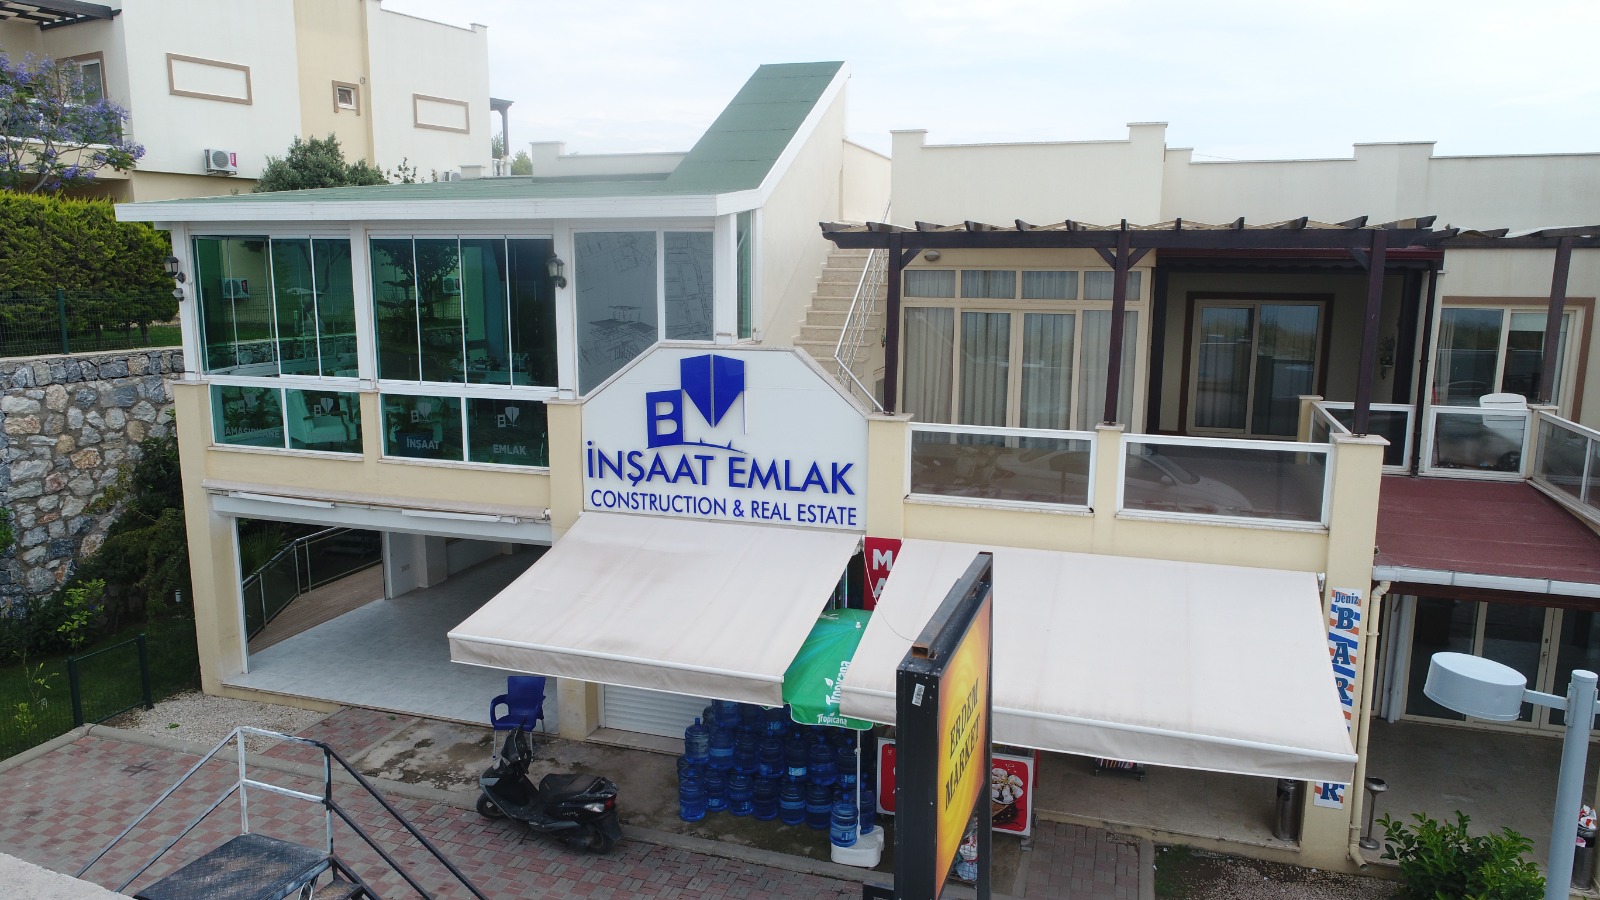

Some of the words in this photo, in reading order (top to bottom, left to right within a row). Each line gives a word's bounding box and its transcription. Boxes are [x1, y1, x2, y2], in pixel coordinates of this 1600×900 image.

[406, 437, 440, 450] İNŞAAT
[493, 444, 527, 455] EMLAK
[587, 440, 717, 487] İNŞAAT
[728, 456, 855, 496] EMLAK
[591, 489, 726, 516] CONSTRUCTION
[733, 501, 745, 518] &
[751, 500, 792, 521] REAL
[797, 504, 857, 526] ESTATE
[1335, 592, 1359, 605] Deniz
[817, 713, 848, 725] Tropicana
[950, 678, 979, 759] ERDEM
[945, 712, 981, 812] MARKET
